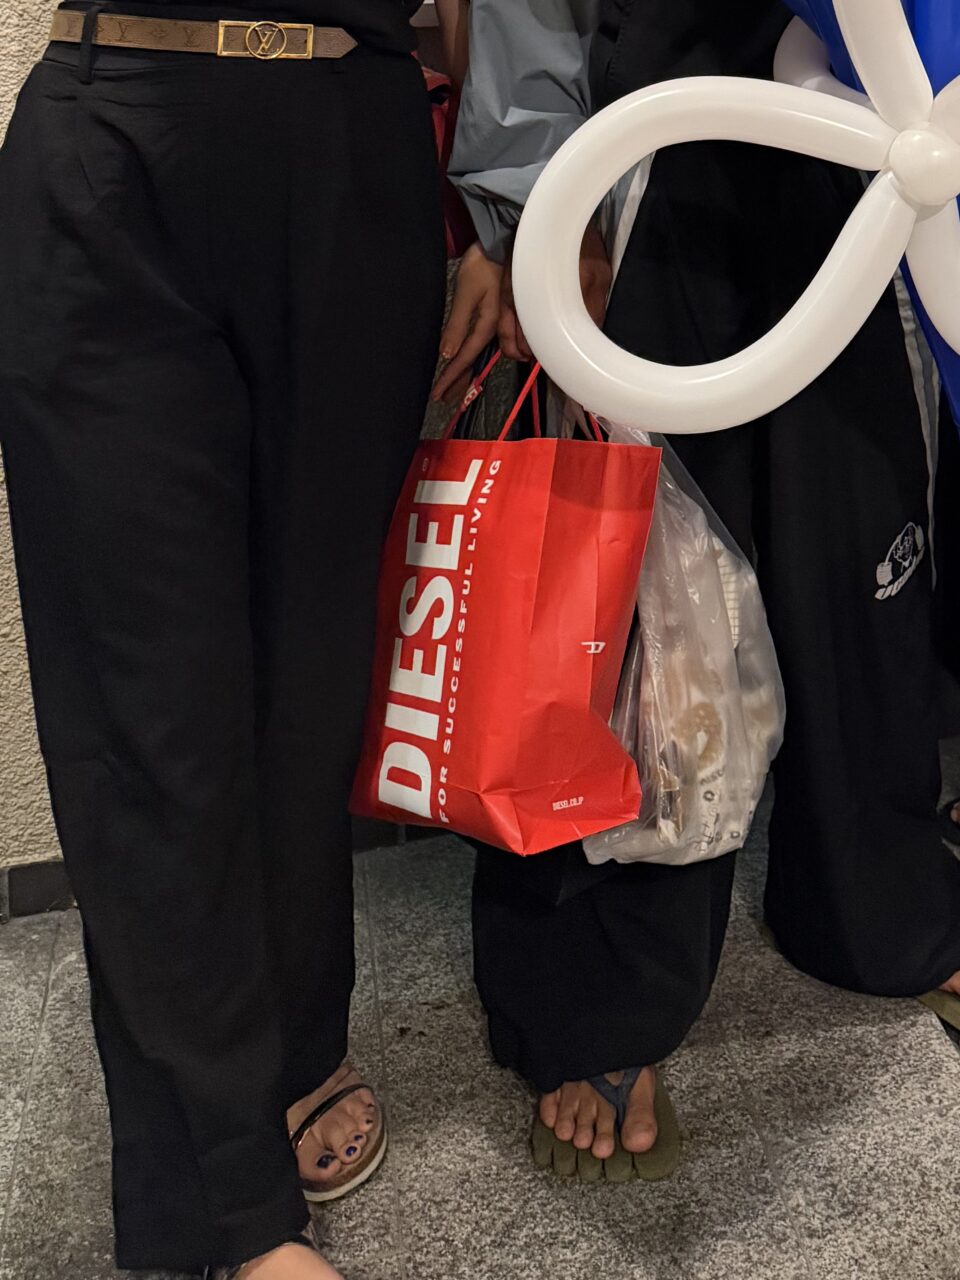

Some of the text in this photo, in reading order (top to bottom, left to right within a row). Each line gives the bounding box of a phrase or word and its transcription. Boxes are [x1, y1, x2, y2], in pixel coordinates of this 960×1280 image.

[378, 458, 484, 819] DIESEL
[437, 459, 502, 823] FOR SUCCESSFUL LIVING
